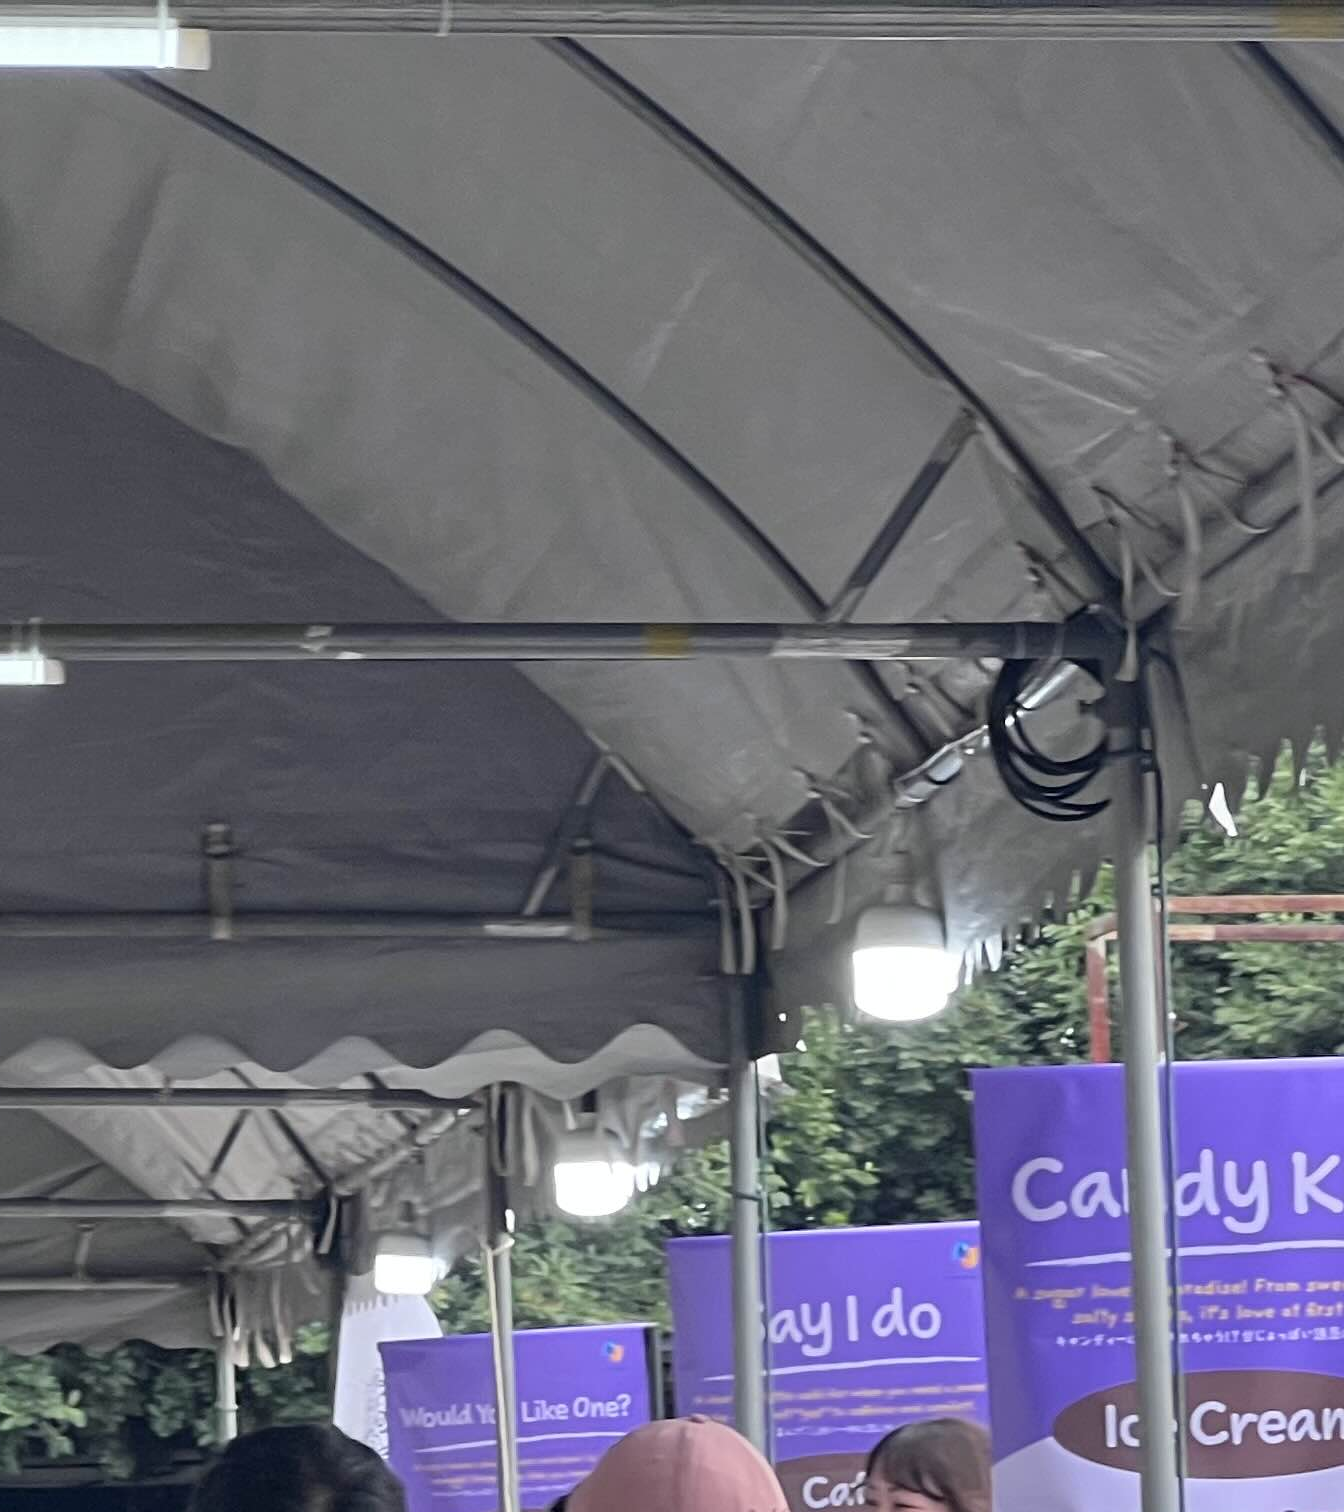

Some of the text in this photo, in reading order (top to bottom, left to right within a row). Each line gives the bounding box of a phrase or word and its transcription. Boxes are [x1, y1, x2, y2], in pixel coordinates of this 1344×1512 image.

[759, 1286, 942, 1357] ay I do
[399, 1404, 472, 1428] Would
[520, 1399, 569, 1423] Like
[573, 1393, 632, 1418] One?
